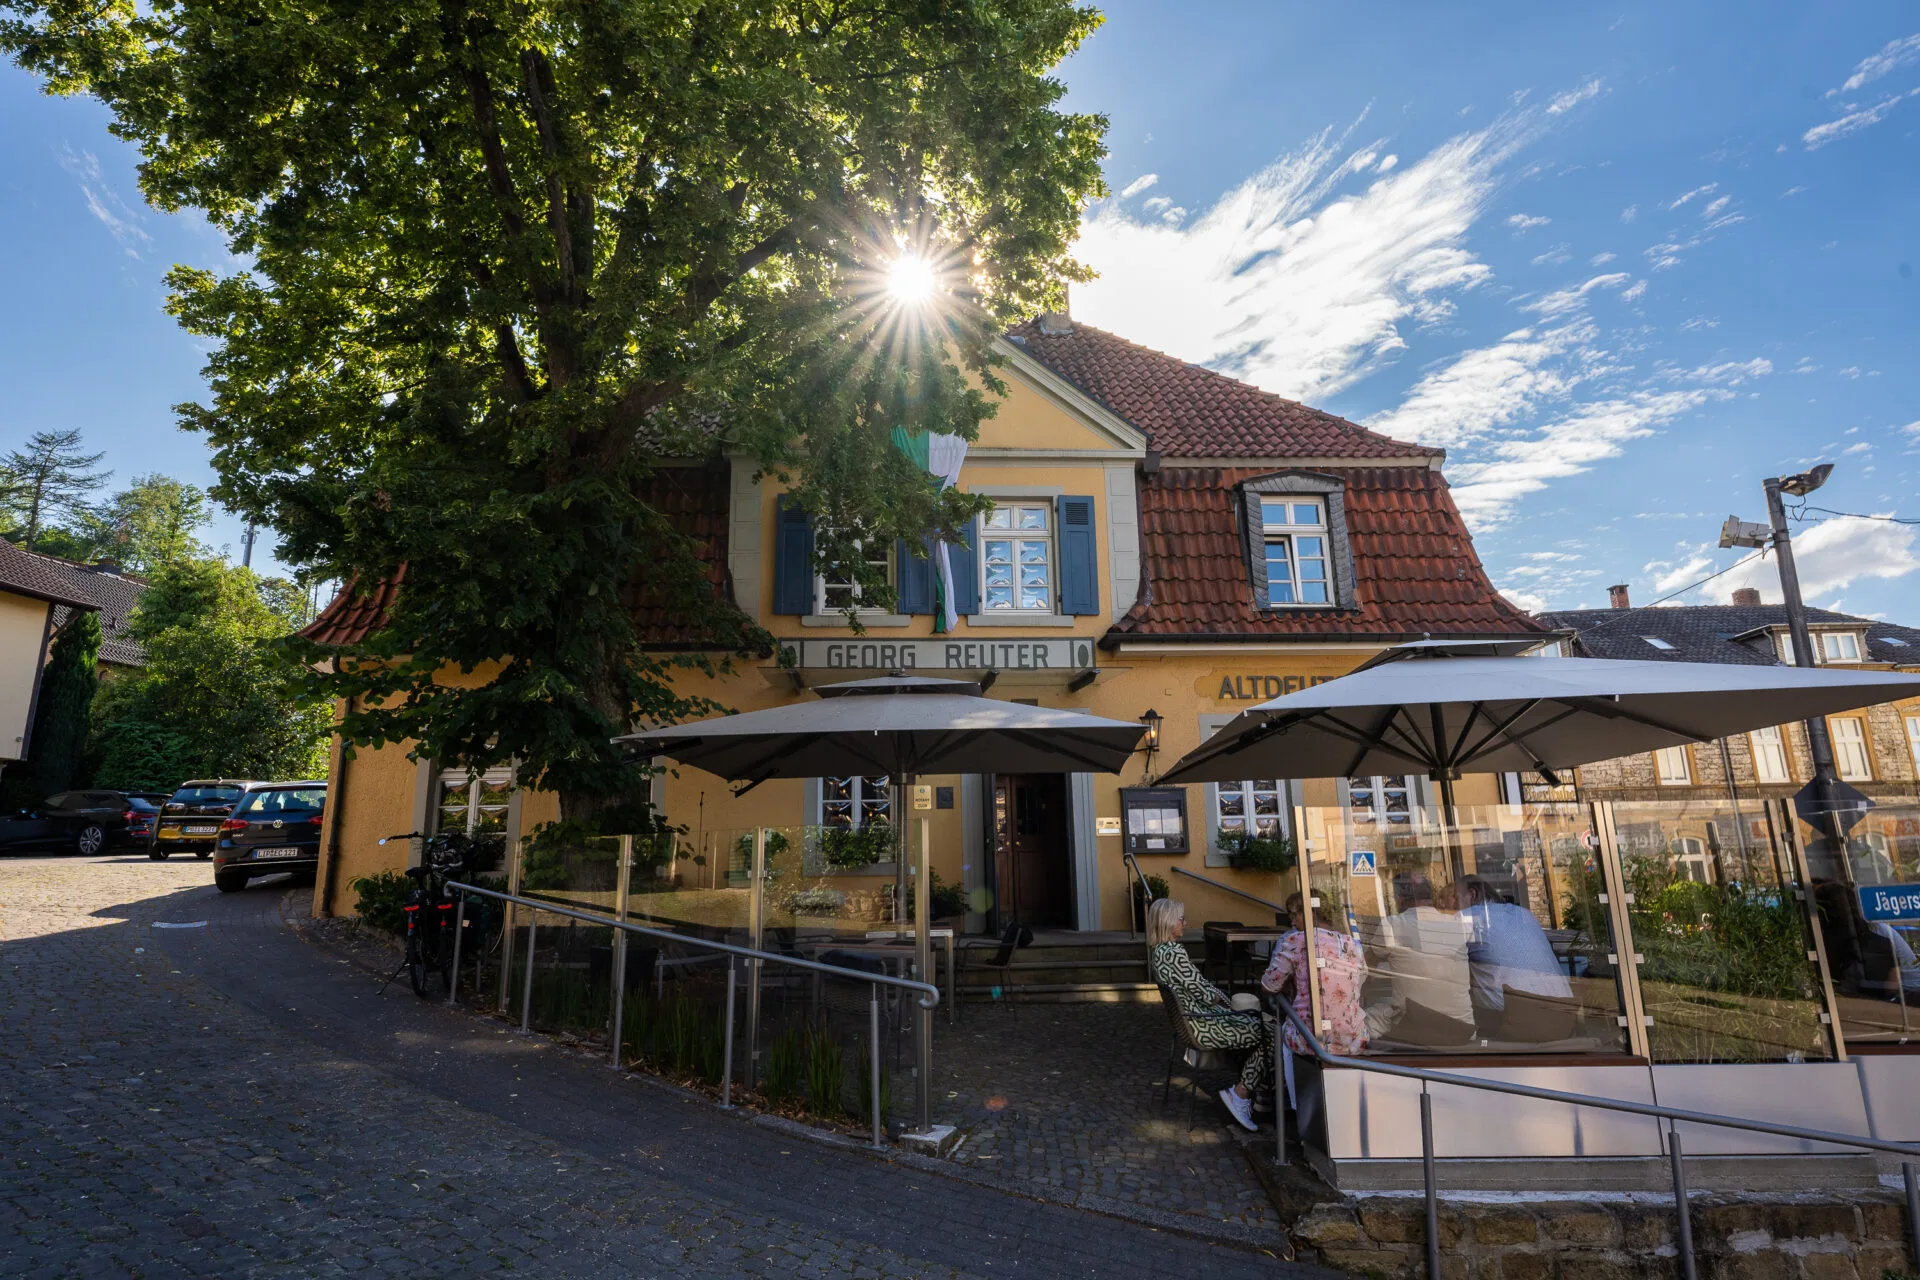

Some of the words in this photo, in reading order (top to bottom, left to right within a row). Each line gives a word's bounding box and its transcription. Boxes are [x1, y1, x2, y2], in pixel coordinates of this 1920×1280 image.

[827, 644, 916, 669] GEORG
[945, 643, 1049, 669] REUTER
[1219, 674, 1342, 699] ALTDEUT
[1874, 891, 1920, 916] Jägers
